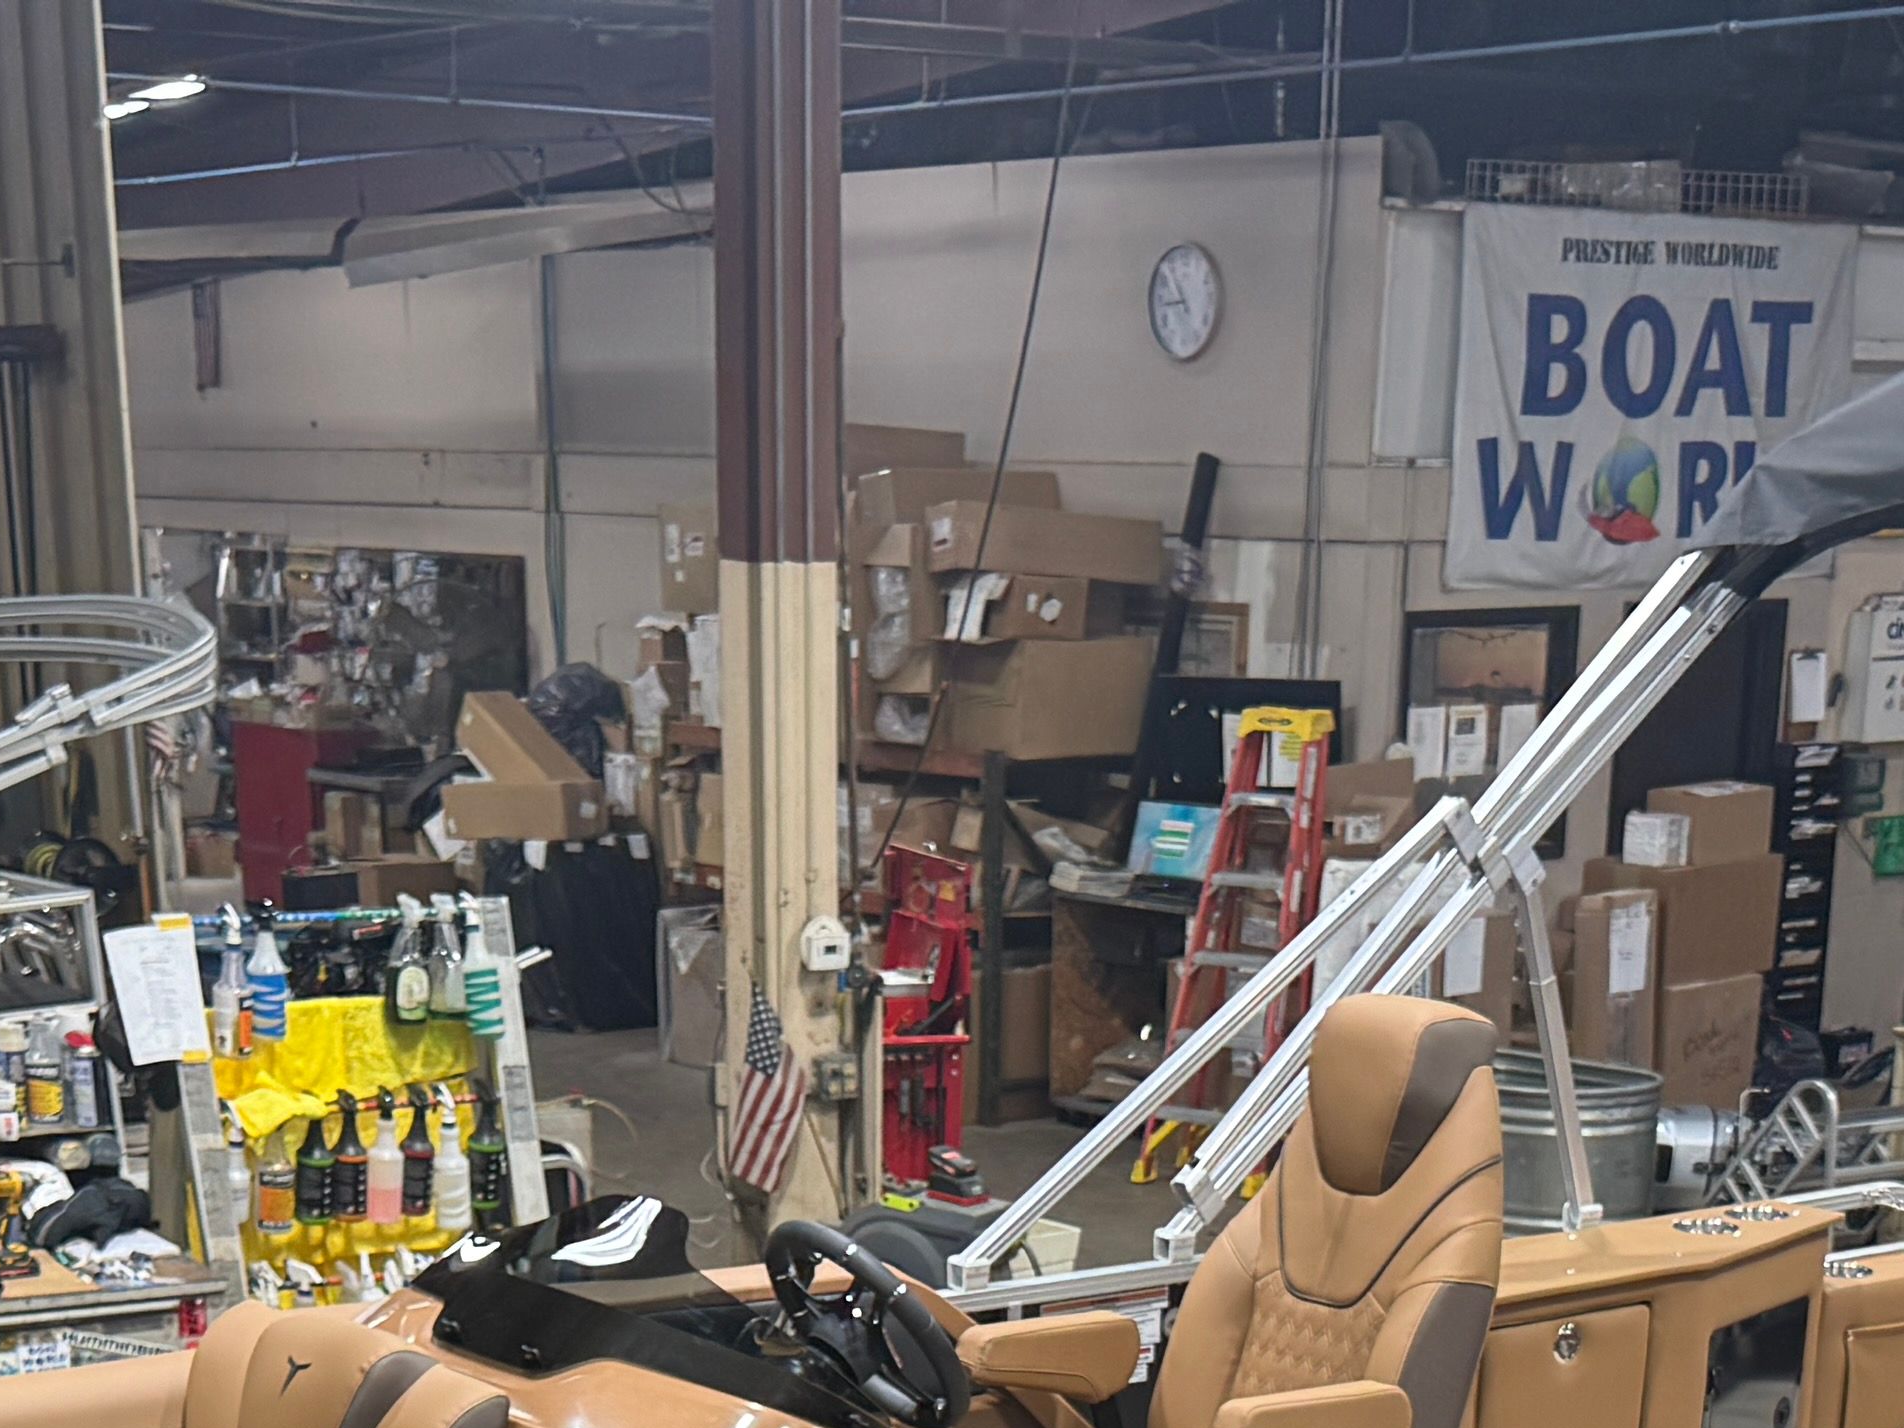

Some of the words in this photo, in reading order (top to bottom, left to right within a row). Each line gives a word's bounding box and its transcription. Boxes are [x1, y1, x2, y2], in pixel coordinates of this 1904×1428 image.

[1562, 238, 1655, 265] PRESTIGE
[1665, 240, 1780, 270] WORLDWIDE
[1520, 293, 1813, 419] BOAT
